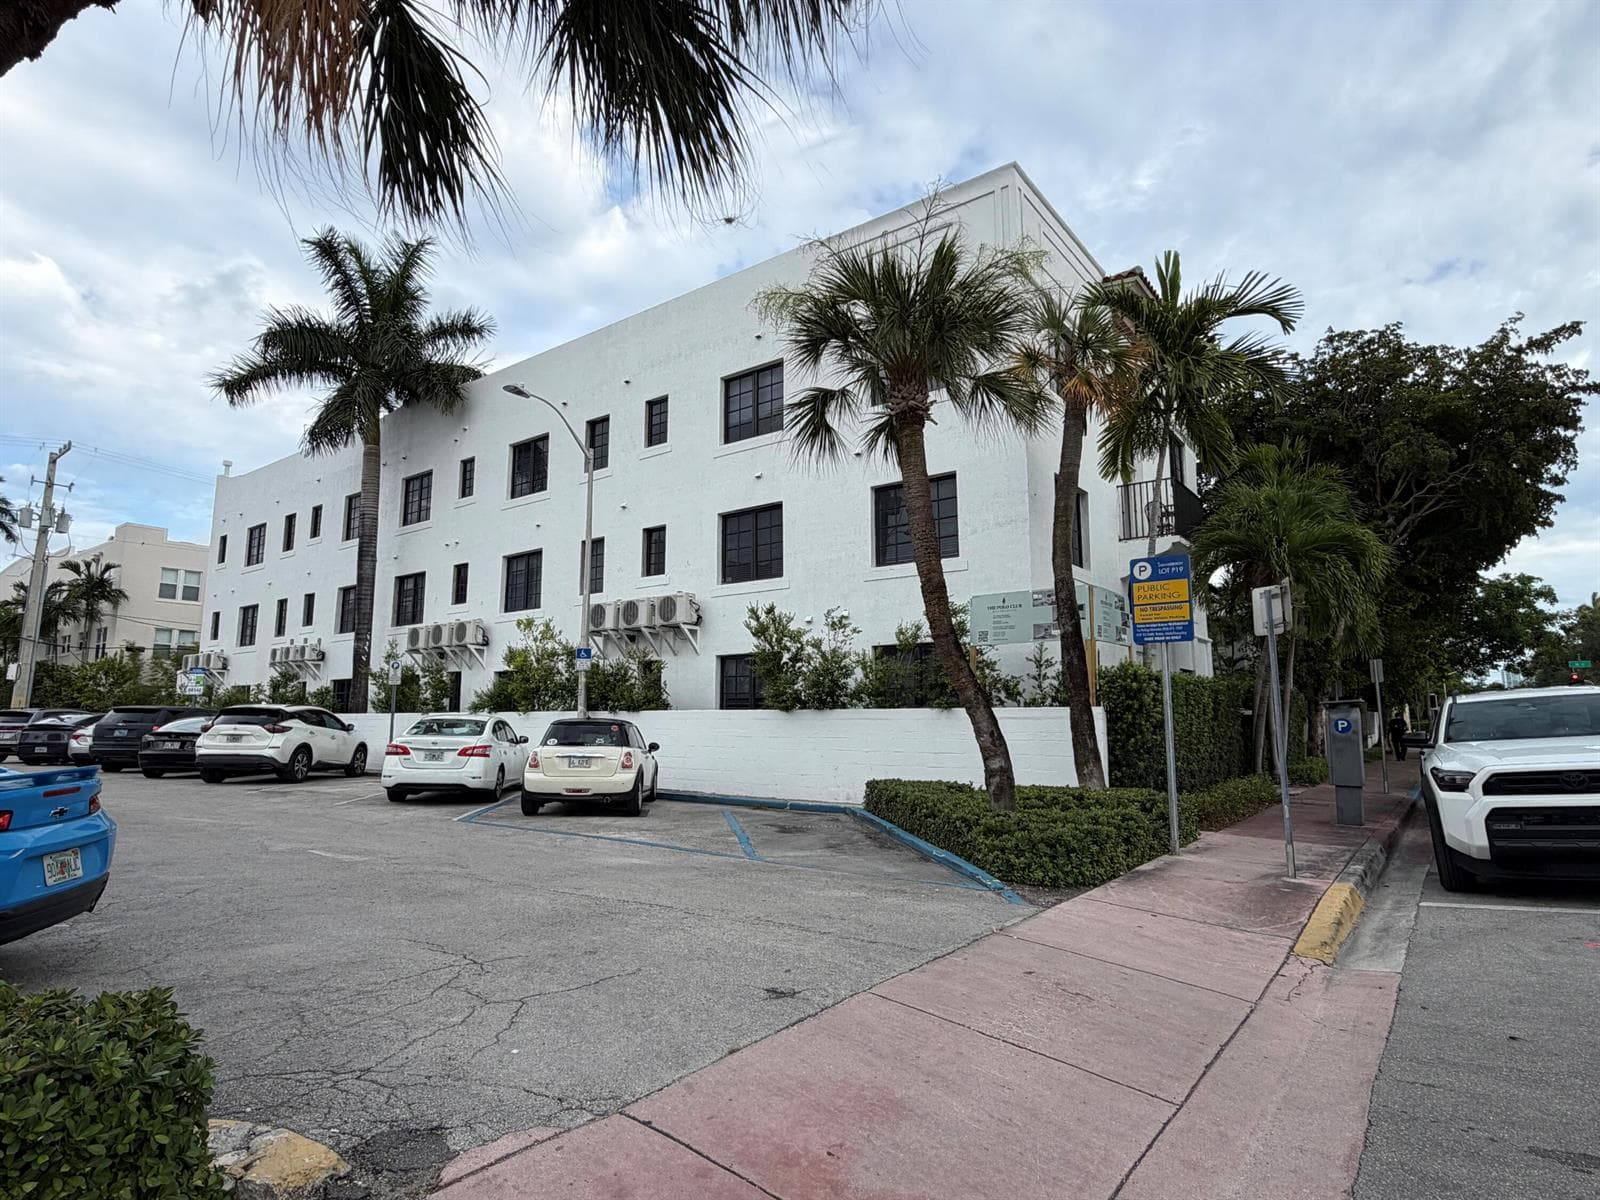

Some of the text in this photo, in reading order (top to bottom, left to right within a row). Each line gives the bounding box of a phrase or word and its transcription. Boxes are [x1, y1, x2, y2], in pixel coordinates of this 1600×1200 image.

[1138, 565, 1147, 576] P
[1137, 583, 1170, 593] PUBLIC
[1137, 591, 1181, 601] PARKING
[1149, 604, 1184, 612] TRESPASSING
[1337, 720, 1348, 731] P
